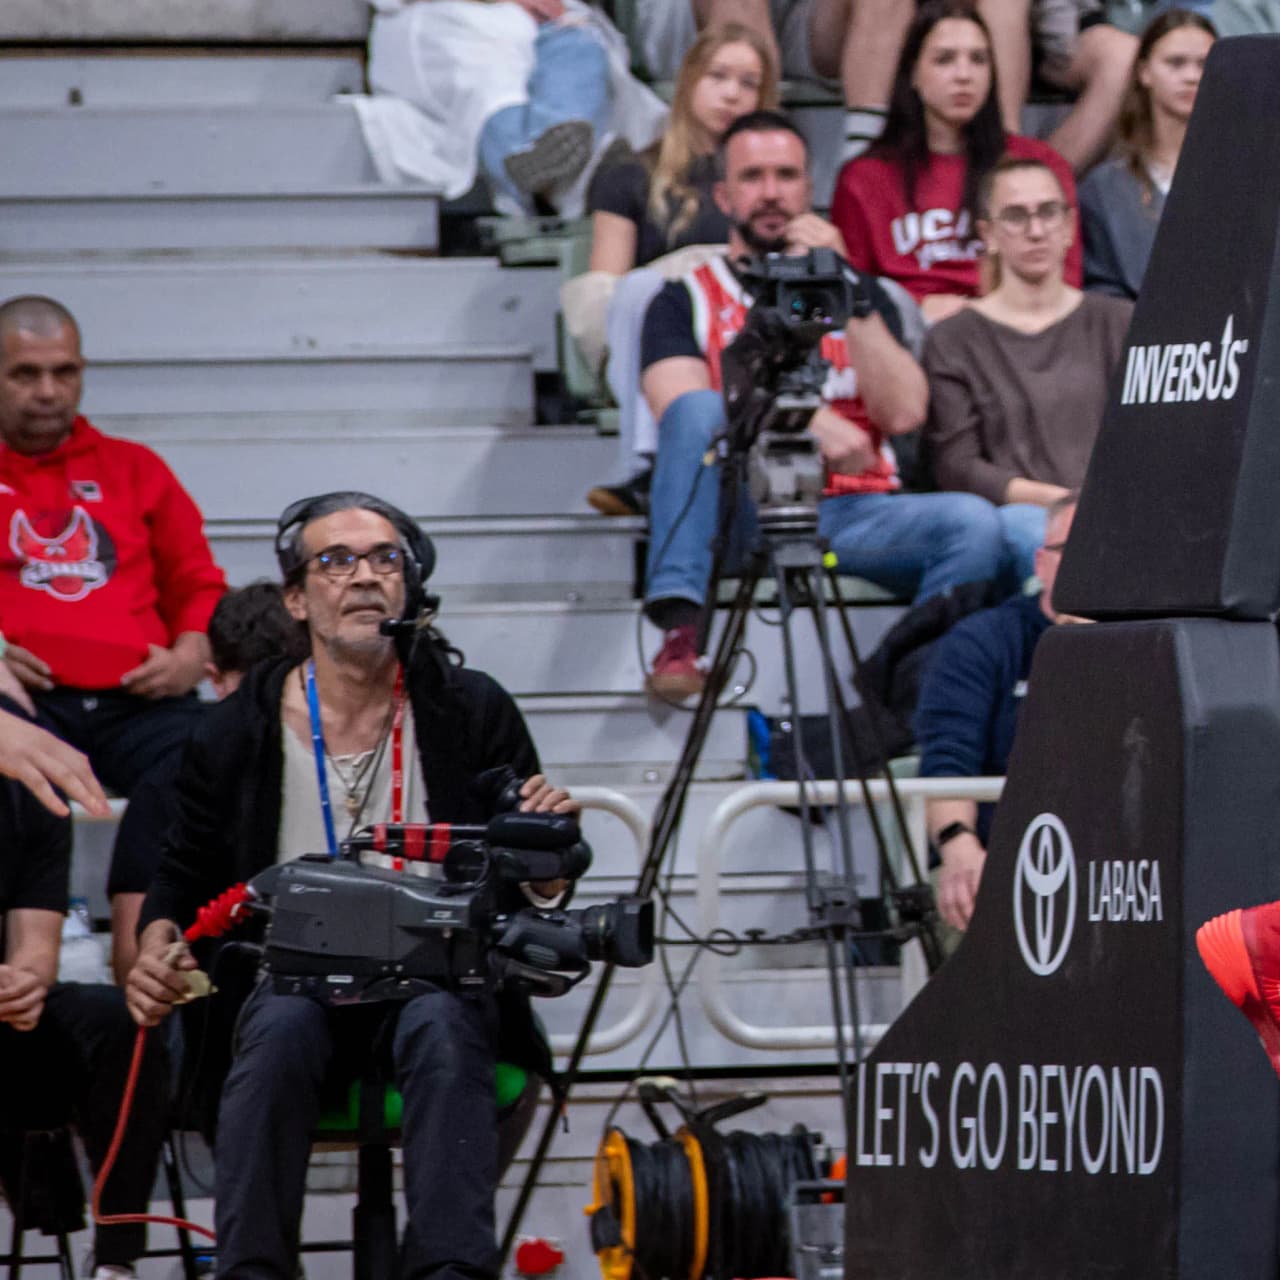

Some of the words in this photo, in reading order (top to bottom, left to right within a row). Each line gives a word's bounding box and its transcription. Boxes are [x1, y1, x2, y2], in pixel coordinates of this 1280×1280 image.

[1088, 859, 1163, 922] LABASA
[856, 1062, 941, 1169] LET'S
[949, 1062, 1009, 1170] GO
[1017, 1064, 1165, 1175] BEYOND
